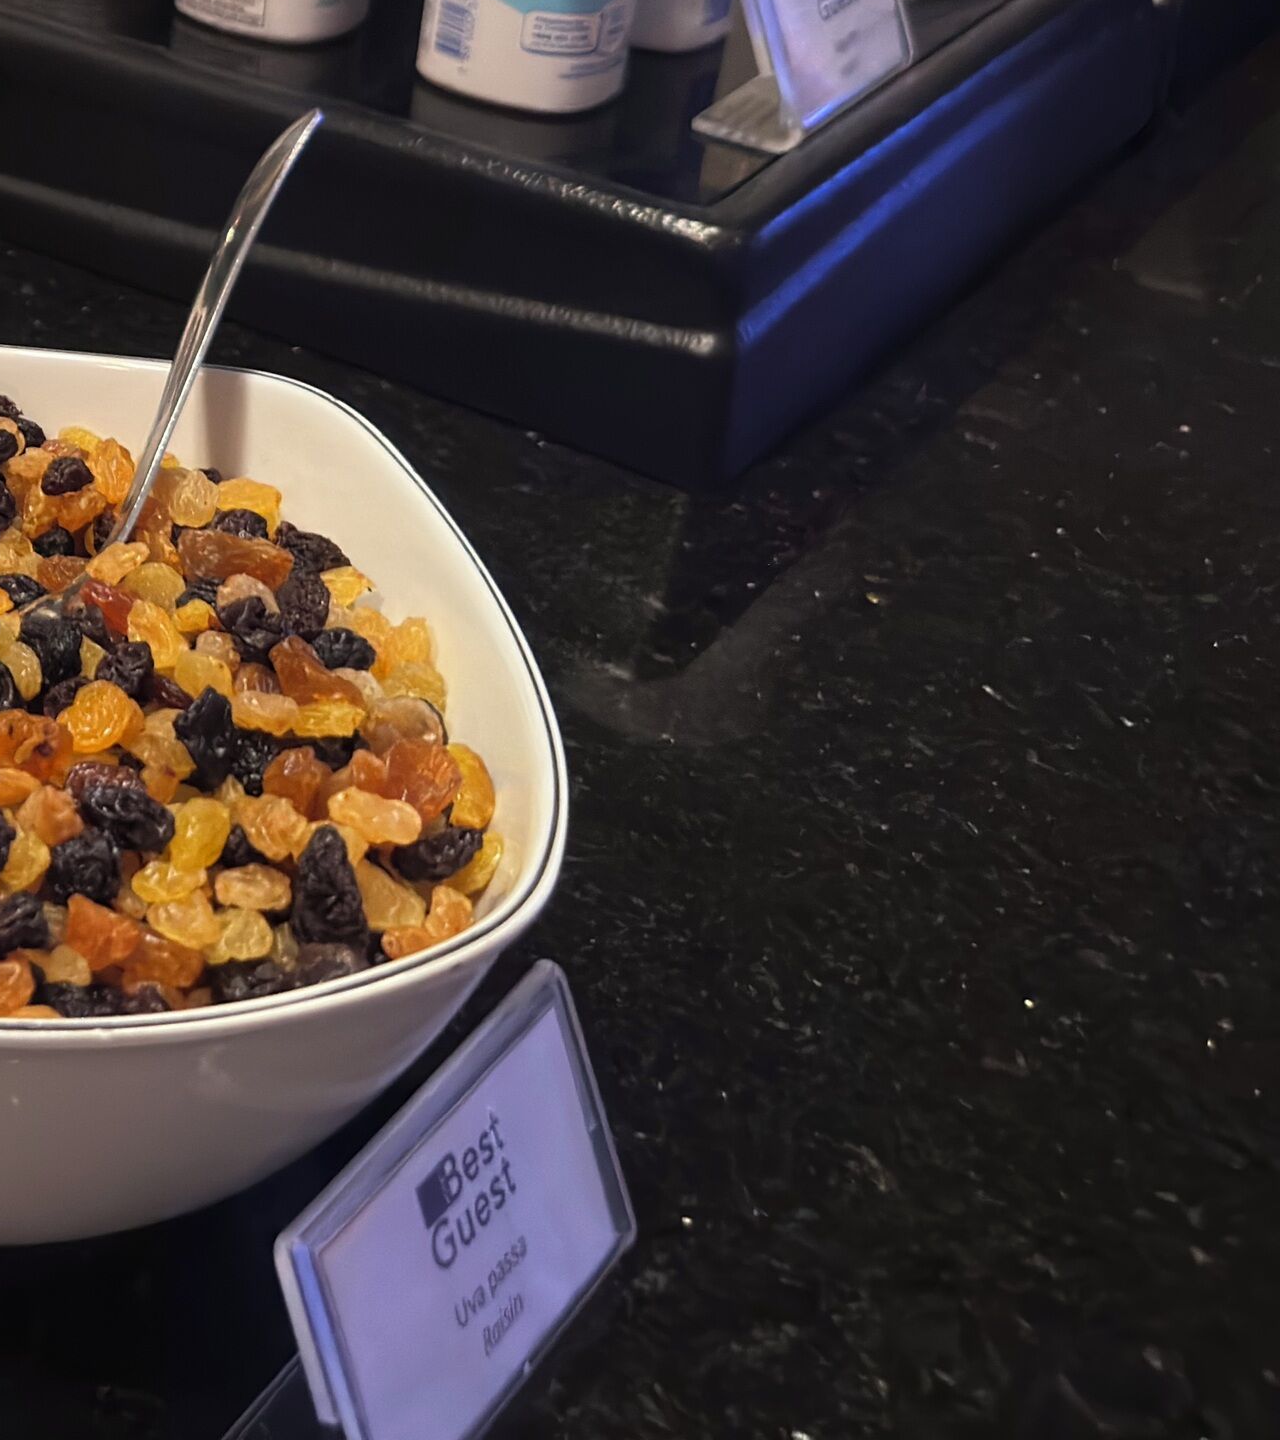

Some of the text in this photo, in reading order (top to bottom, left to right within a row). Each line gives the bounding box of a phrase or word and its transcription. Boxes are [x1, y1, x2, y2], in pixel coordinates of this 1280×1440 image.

[439, 1111, 505, 1207] Best
[431, 1157, 517, 1269] Guest
[454, 1235, 527, 1329] Uva passa
